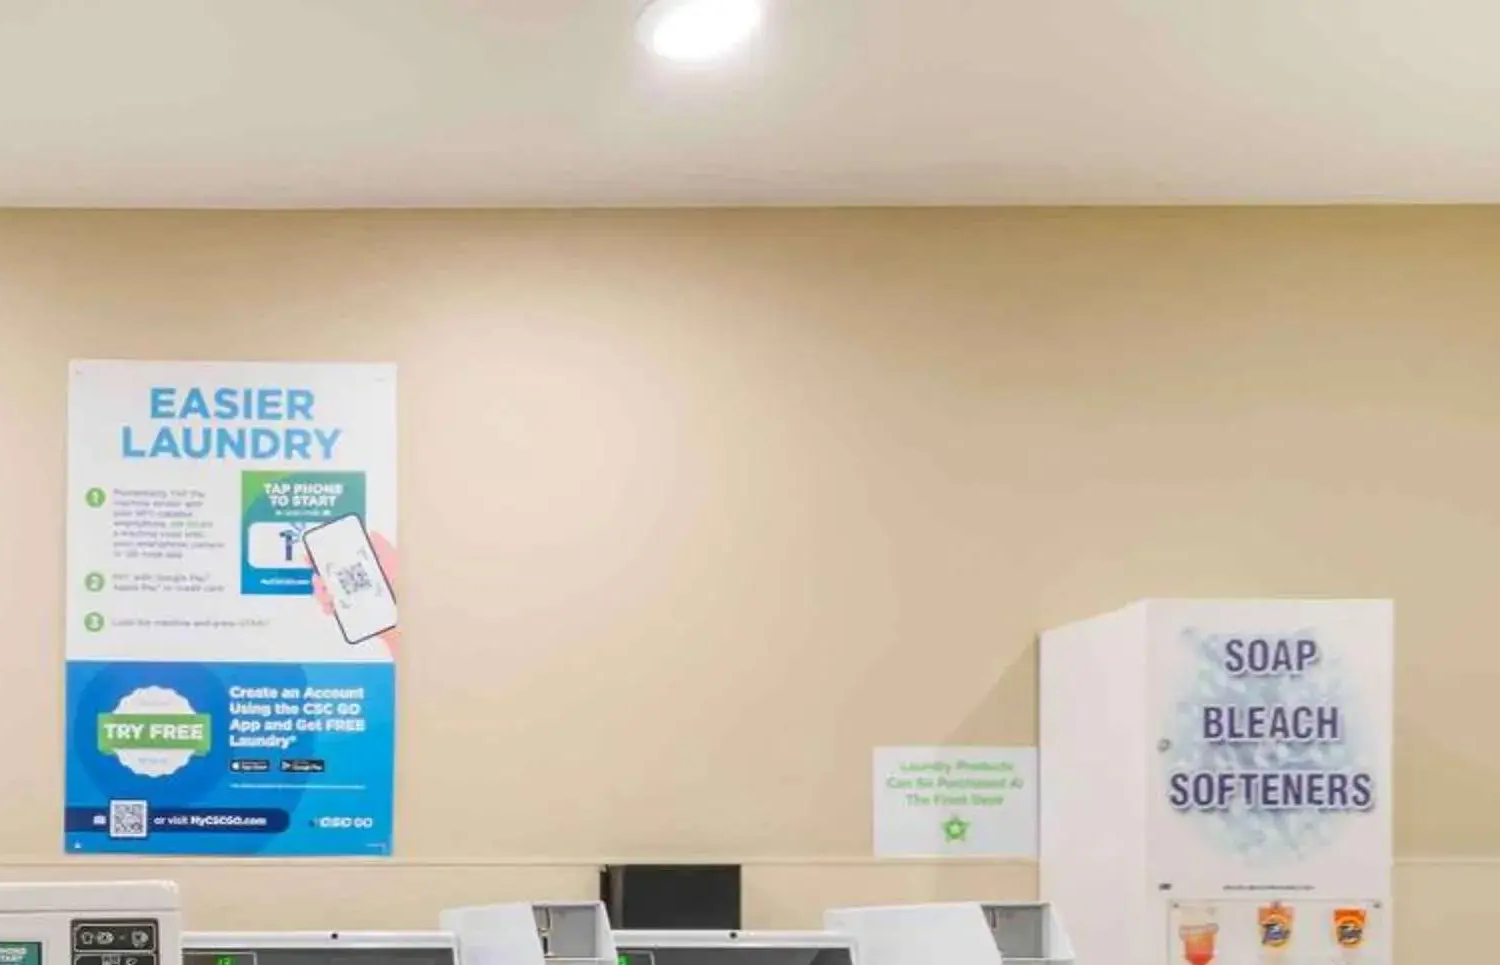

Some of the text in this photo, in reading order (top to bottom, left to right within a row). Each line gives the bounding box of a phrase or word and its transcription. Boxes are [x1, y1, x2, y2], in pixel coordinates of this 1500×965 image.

[150, 387, 315, 420] EASIER
[121, 426, 342, 459] LAUNDRY
[264, 483, 344, 495] TAP PHONE
[270, 496, 337, 507] TO START
[1224, 638, 1318, 673] SOAP
[229, 686, 364, 700] Create an Account
[229, 701, 361, 717] Using the CSC GO
[229, 718, 366, 733] App and Get FREE
[1202, 705, 1339, 740] BLEACH
[103, 723, 204, 740] TRY FREE
[900, 761, 951, 775] Laundry
[886, 777, 913, 788] Can
[1168, 772, 1373, 807] SOFTENERS
[153, 817, 165, 825] or
[168, 815, 189, 825] visit
